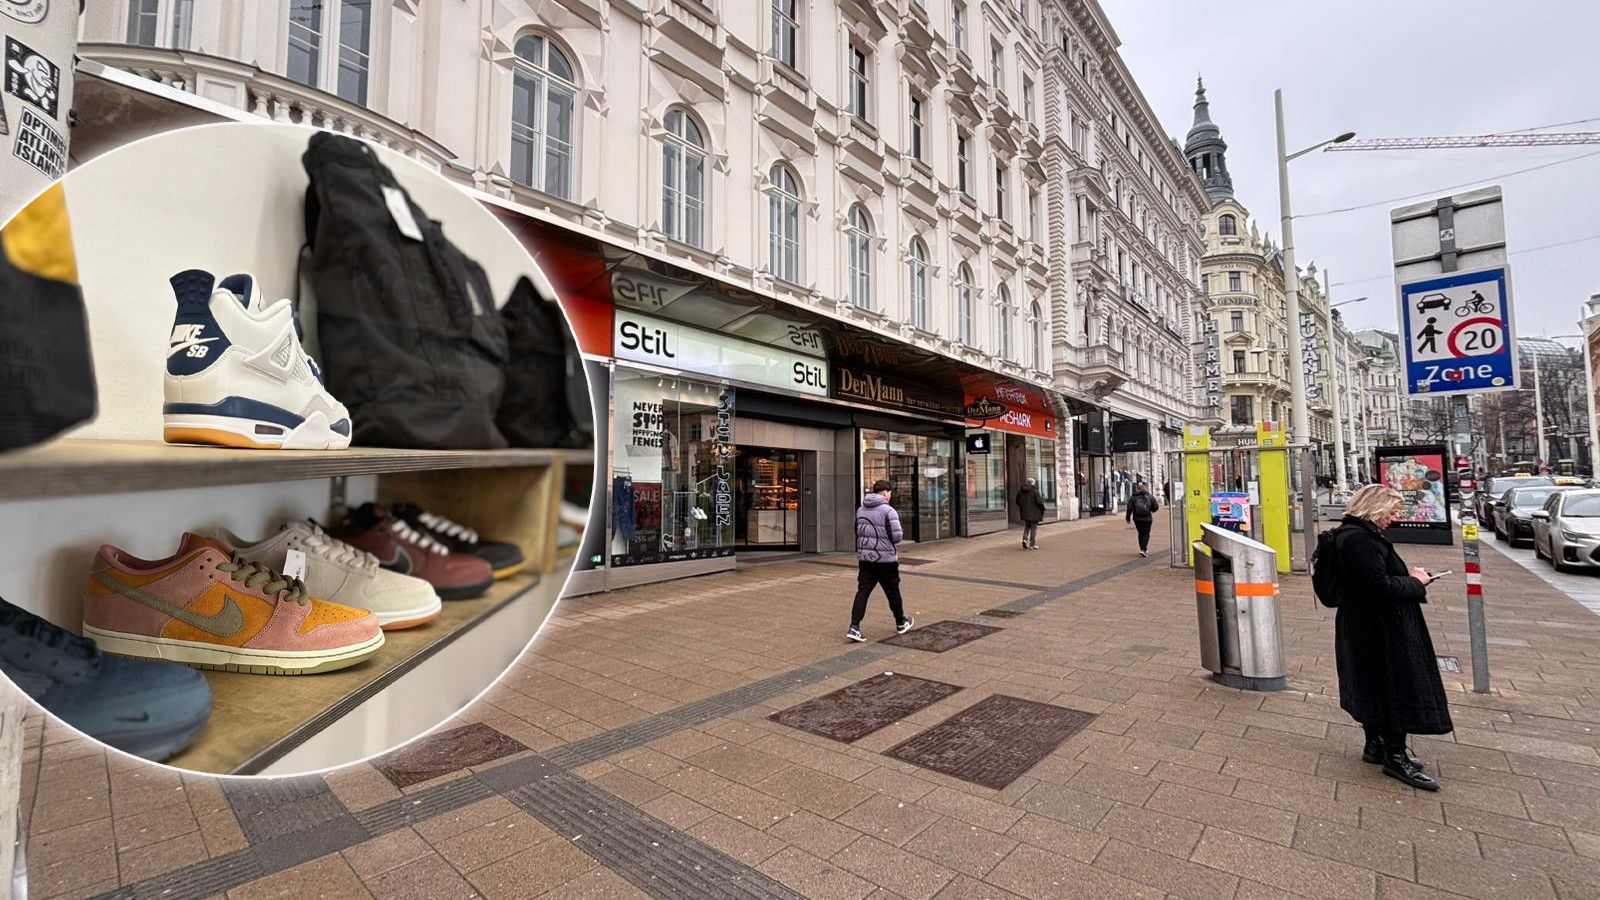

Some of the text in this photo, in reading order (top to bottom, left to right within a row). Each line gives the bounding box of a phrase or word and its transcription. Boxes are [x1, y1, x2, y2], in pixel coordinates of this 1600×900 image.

[171, 324, 205, 342] NIKE
[620, 321, 675, 358] Stil
[1463, 328, 1496, 351] 20
[187, 345, 209, 358] SB
[1300, 314, 1320, 399] HUMANIC
[1204, 320, 1220, 406] HIRMER
[793, 362, 826, 388] Stil
[633, 402, 664, 413] NEVER
[633, 412, 664, 430] STOP
[633, 437, 664, 448] FENCES
[633, 489, 660, 502] SALE
